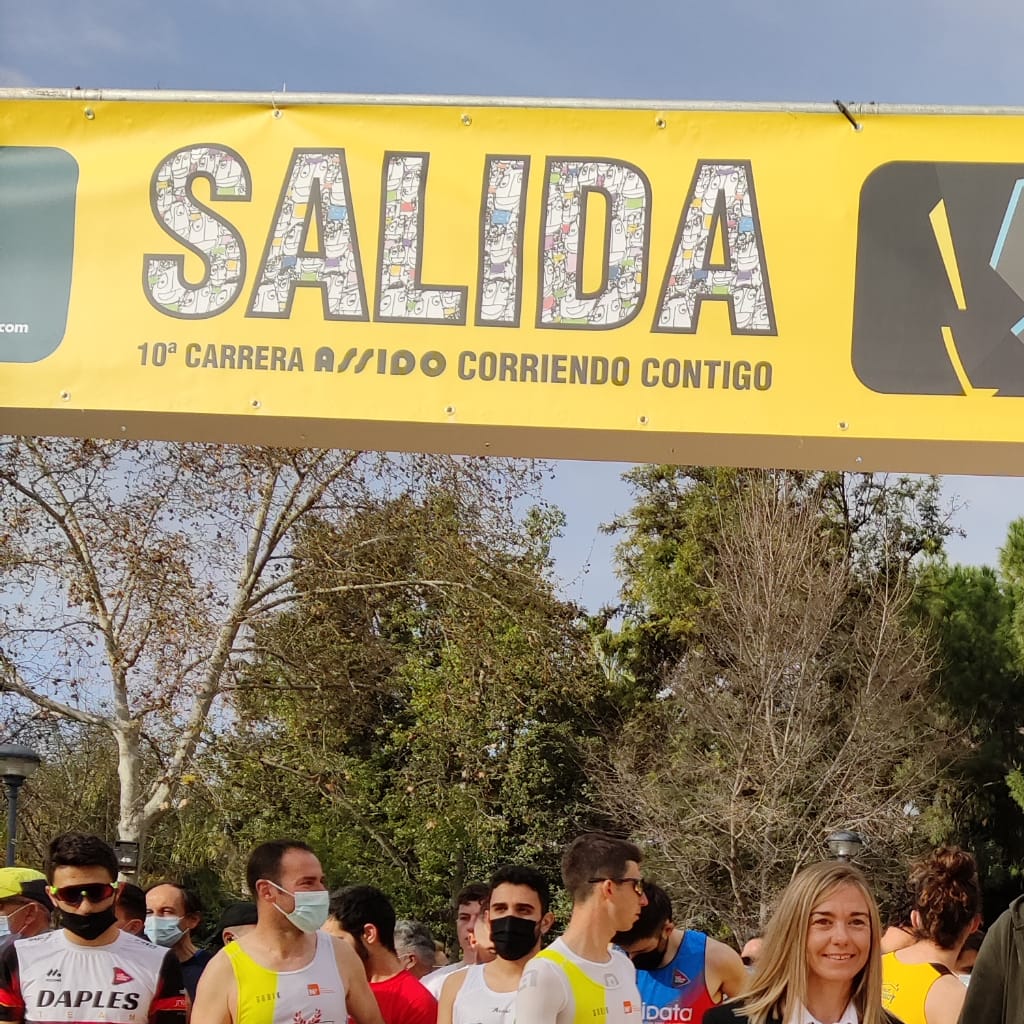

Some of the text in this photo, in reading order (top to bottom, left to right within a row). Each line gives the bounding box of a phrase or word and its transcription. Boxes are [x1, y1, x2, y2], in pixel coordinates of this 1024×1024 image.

[142, 142, 778, 336] SALIDA
[185, 342, 304, 372] CARRERA
[313, 346, 447, 378] ASSIDO
[457, 350, 631, 387] CORRIENDO
[640, 357, 774, 391] CONTIGO
[36, 989, 140, 1010] DAPLES
